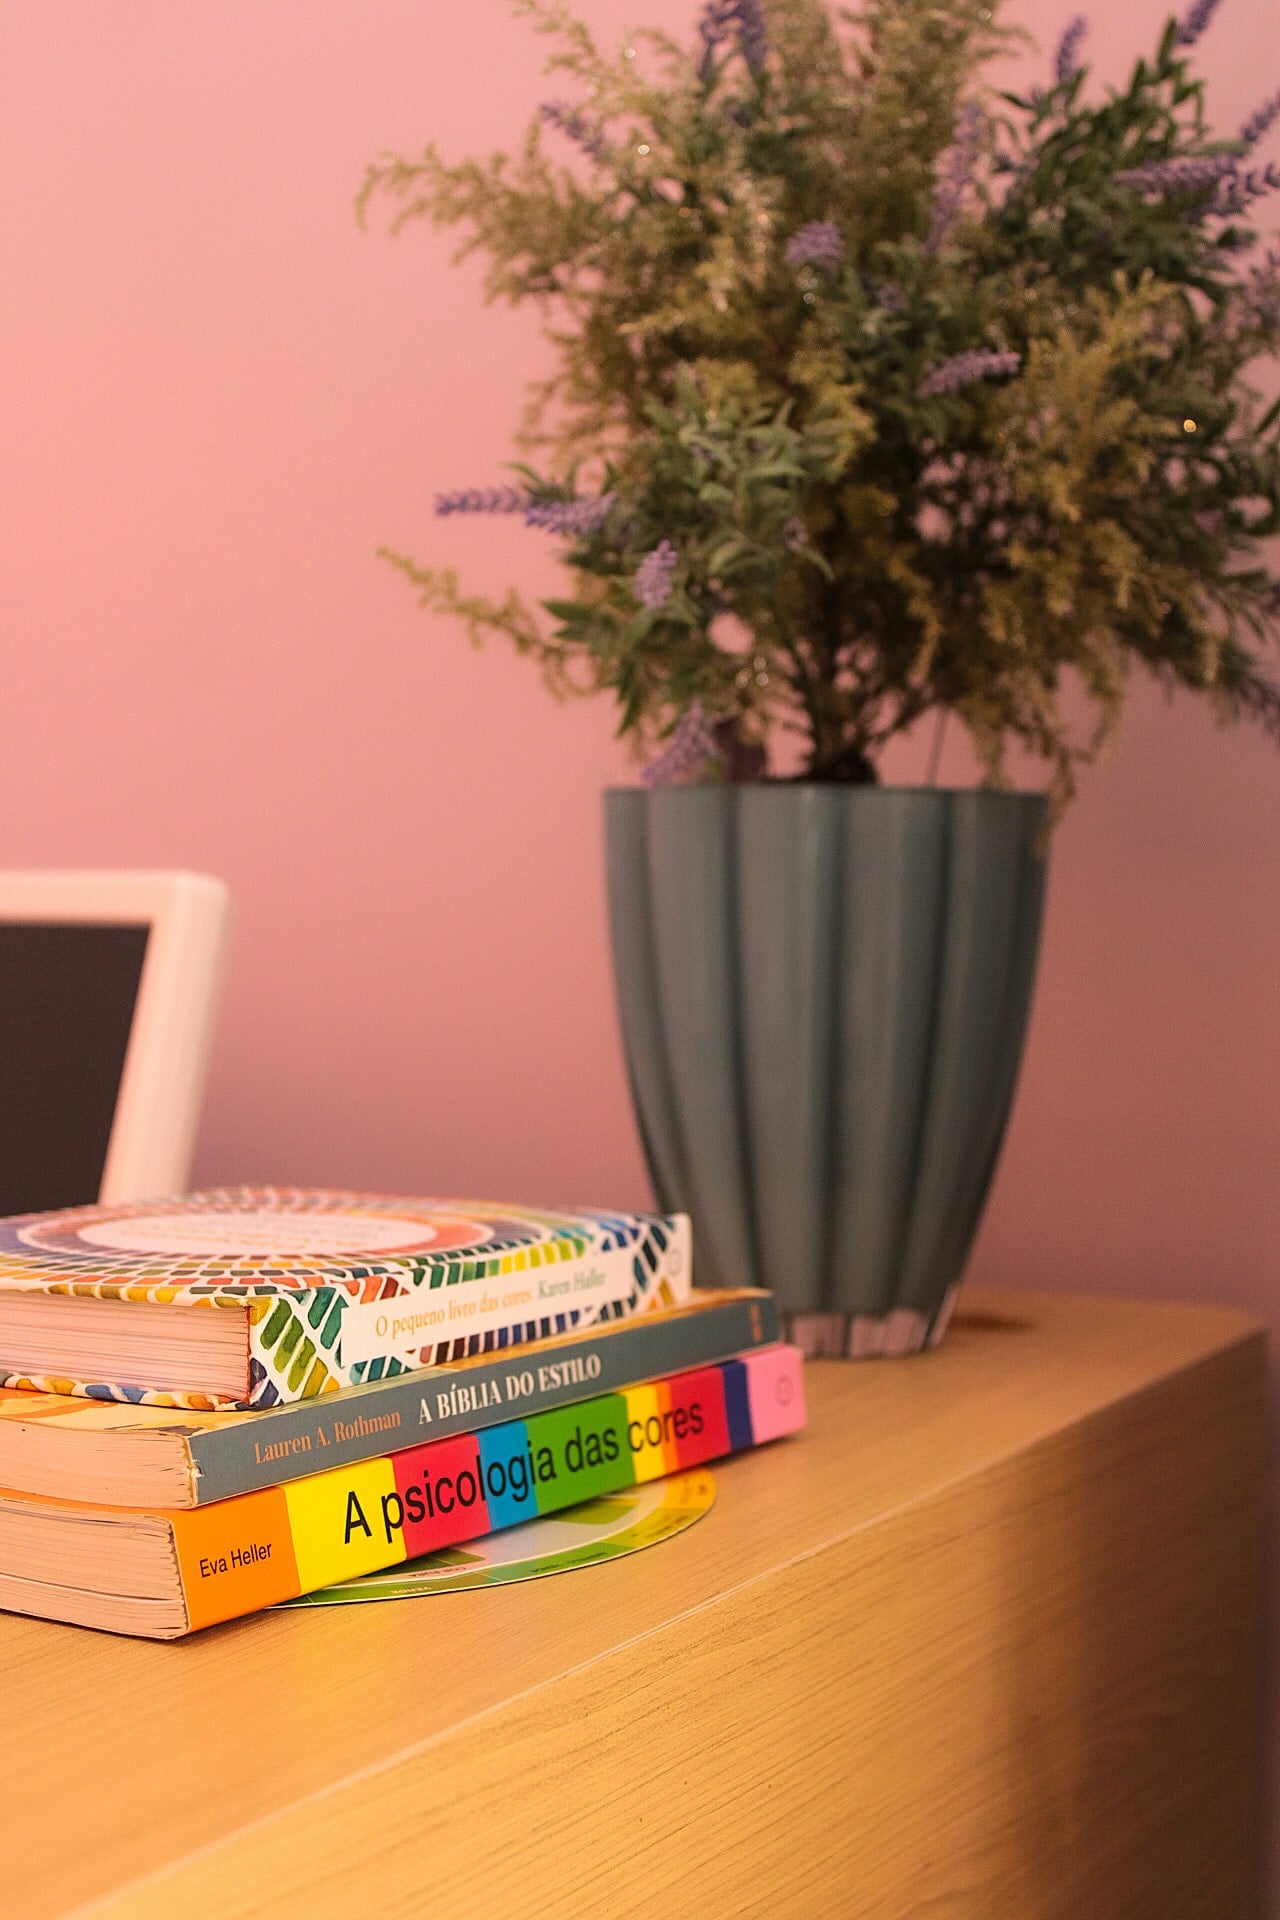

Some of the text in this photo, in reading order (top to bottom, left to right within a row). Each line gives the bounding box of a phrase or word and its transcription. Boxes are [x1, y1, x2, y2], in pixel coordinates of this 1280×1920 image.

[375, 1289, 532, 1340] O pequeno livro das cores
[537, 1278, 570, 1300] Karen
[417, 1353, 602, 1425] A BÍBLIA DO ESTILO
[254, 1411, 401, 1465] Lauren A. Rothman
[344, 1402, 704, 1545] A psicologia das cores
[200, 1542, 272, 1579] Eva Heller
